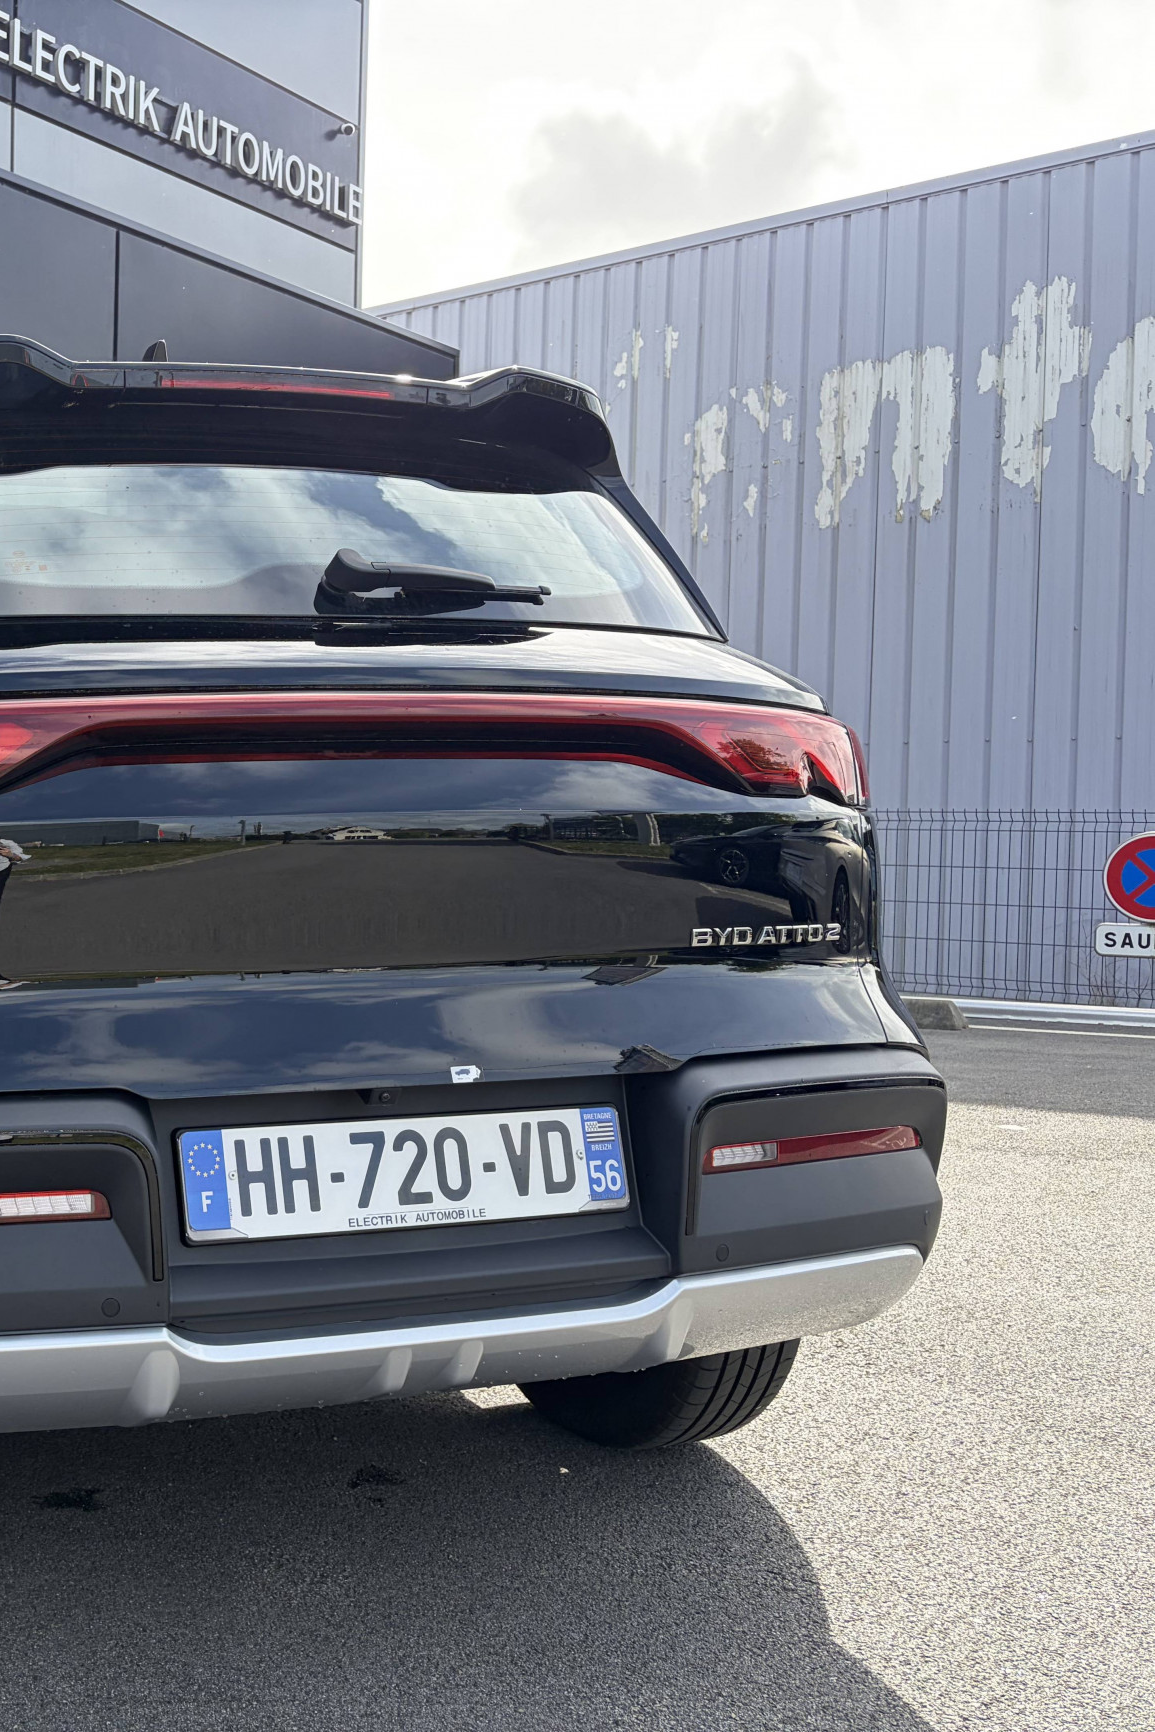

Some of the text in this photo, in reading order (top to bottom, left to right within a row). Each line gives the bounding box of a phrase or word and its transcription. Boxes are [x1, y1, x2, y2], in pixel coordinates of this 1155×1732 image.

[171, 102, 363, 225] AUTOMOBILE
[691, 926, 753, 947] BYD
[1103, 931, 1155, 950] SAU
[583, 1112, 613, 1121] BRETAGNE
[591, 1143, 613, 1152] BREIZH
[233, 1119, 577, 1218] HH-720-VD
[589, 1159, 622, 1193] 56
[201, 1190, 214, 1213] F
[348, 1208, 487, 1229] ELECTRIK AUTOMOBILE
